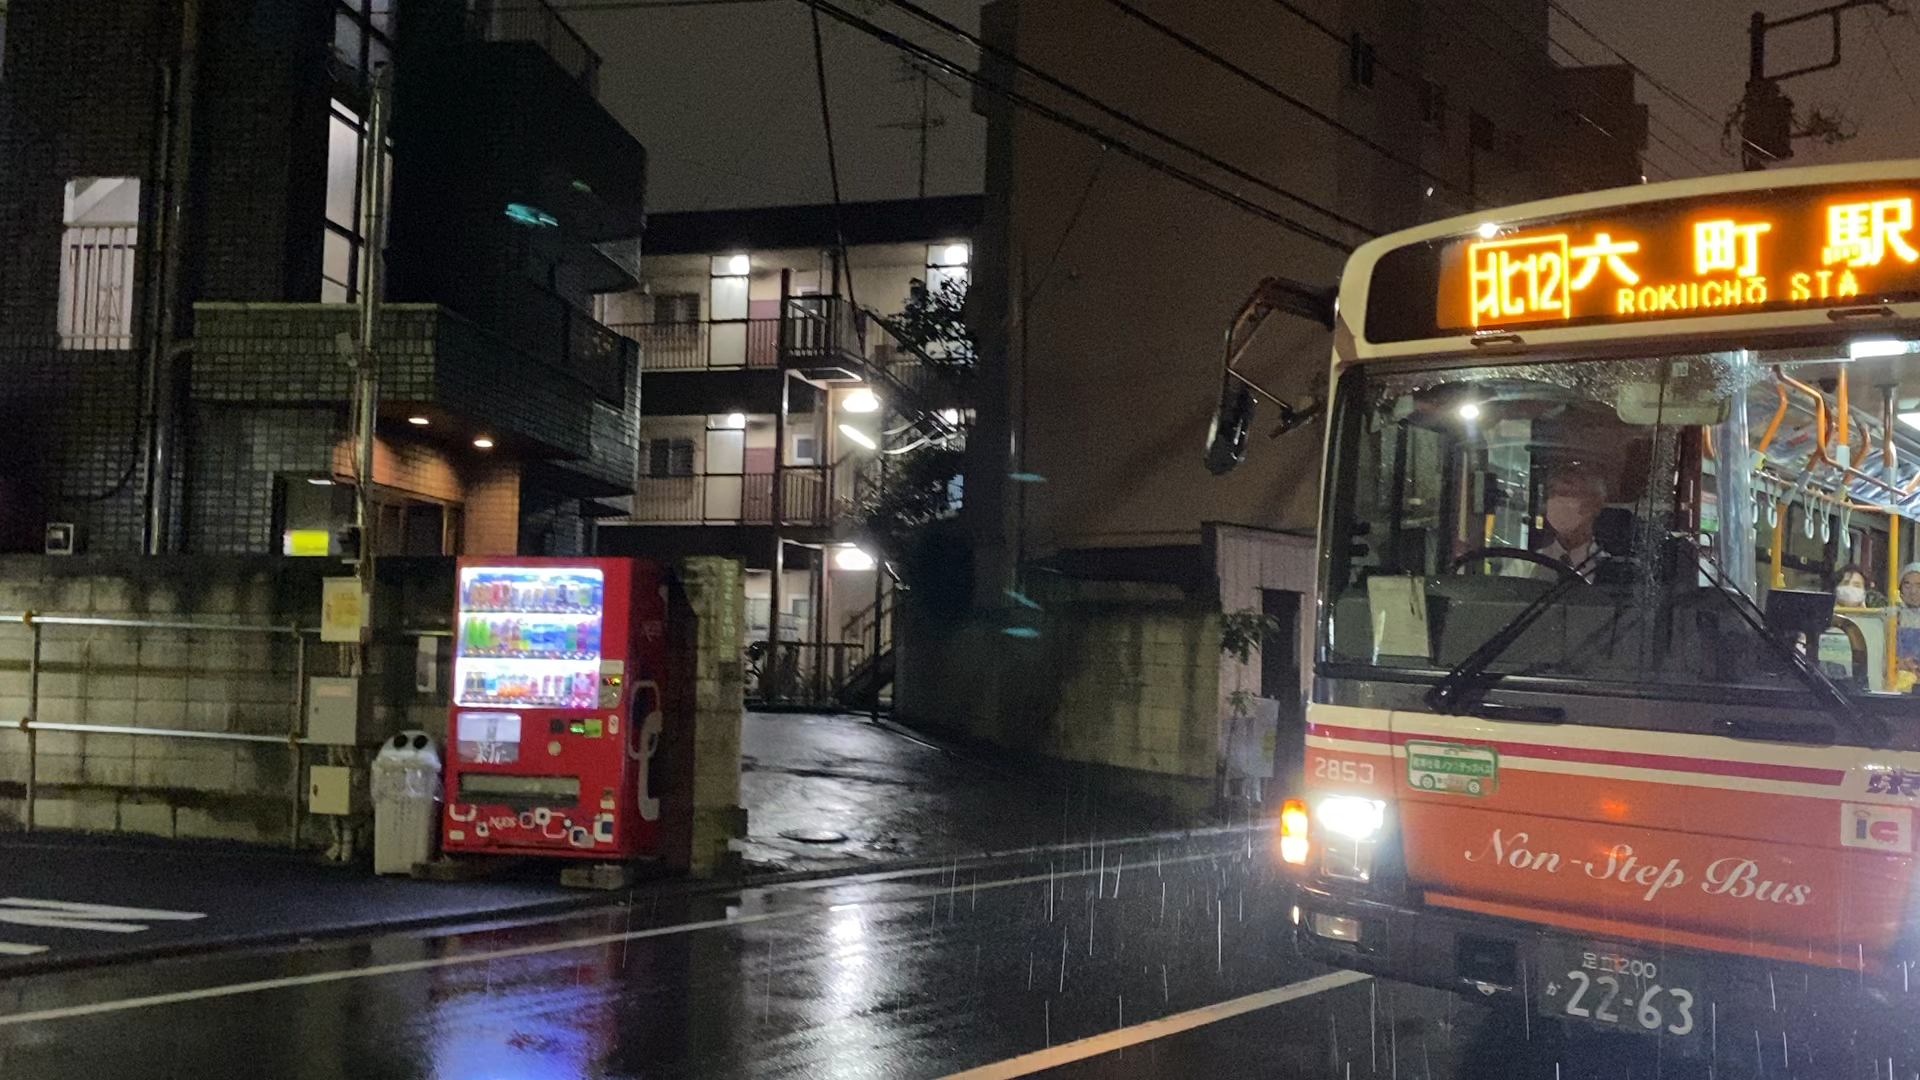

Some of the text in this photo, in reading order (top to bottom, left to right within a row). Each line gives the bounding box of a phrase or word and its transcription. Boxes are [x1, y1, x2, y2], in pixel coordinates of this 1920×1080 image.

[1314, 756, 1375, 785] 2853
[1464, 829, 1812, 906] Non-Step Bus
[1567, 970, 1694, 1035] 22-63
